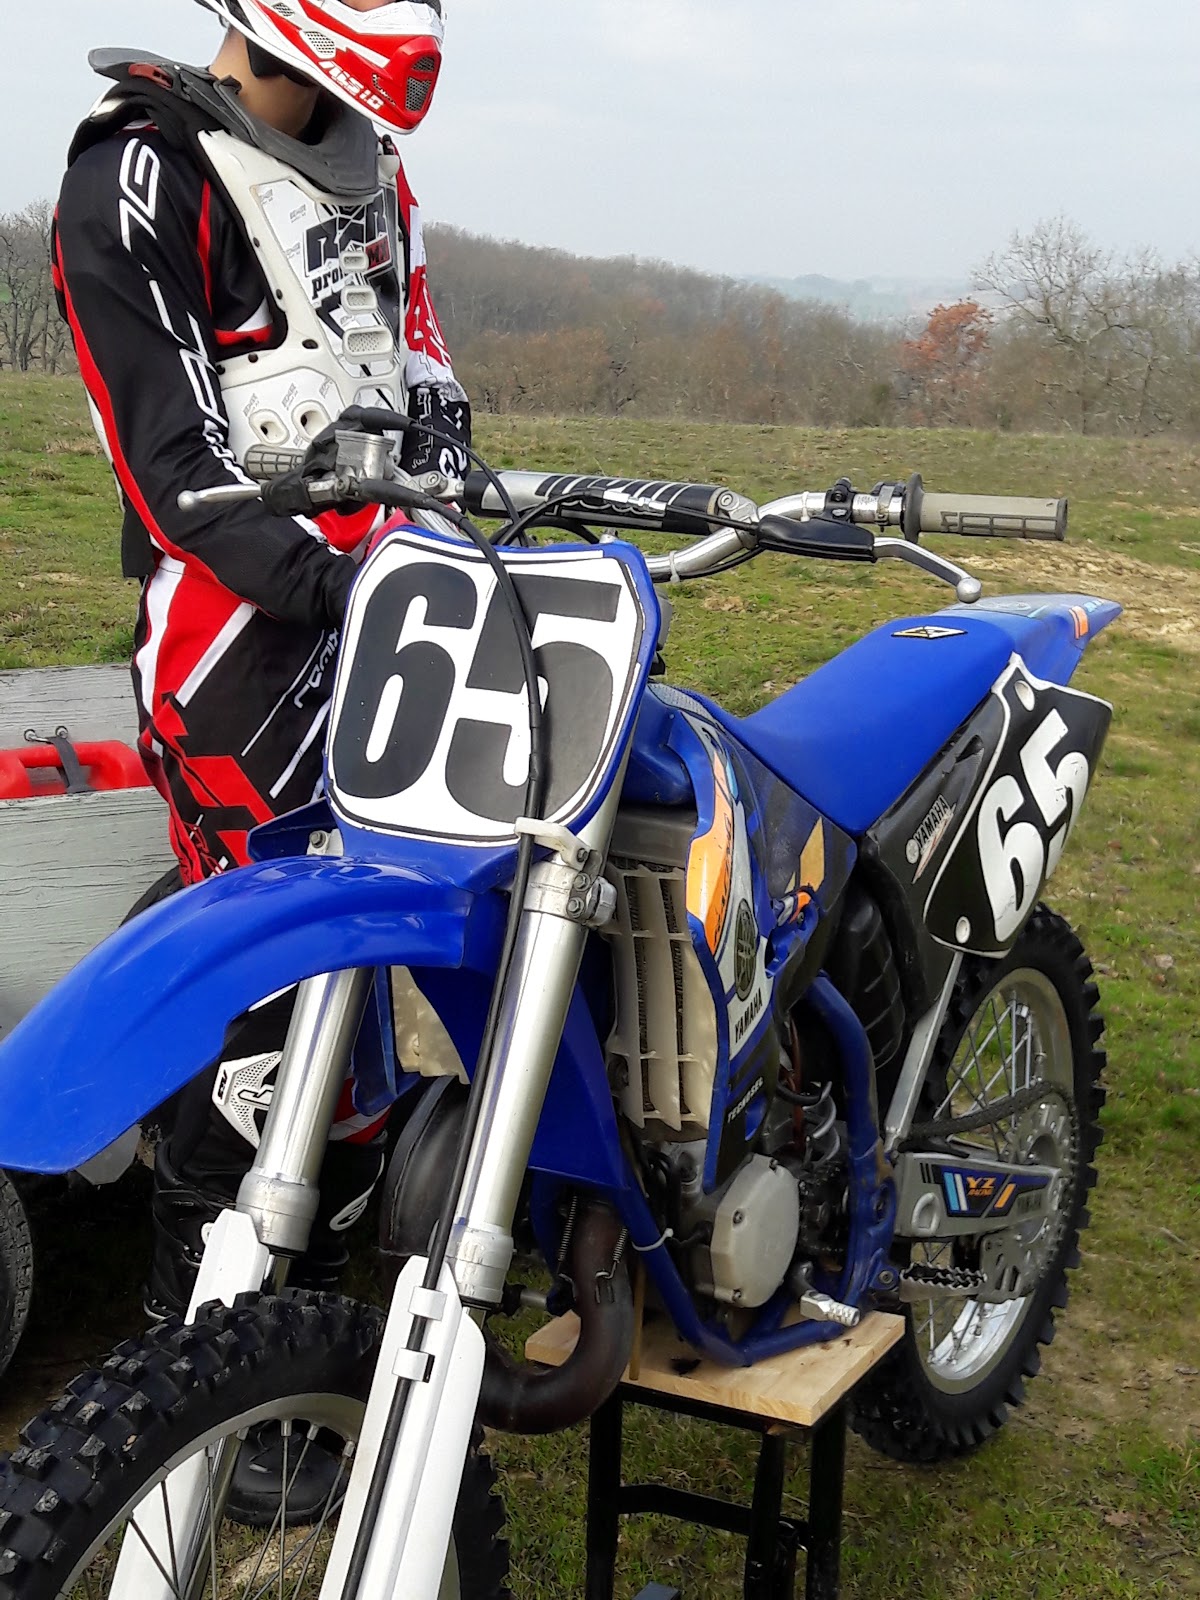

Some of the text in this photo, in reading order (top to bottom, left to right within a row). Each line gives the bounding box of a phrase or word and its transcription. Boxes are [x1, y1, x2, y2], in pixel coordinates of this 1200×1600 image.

[332, 561, 622, 824] 65
[912, 794, 951, 854] YAMAHA
[977, 708, 1089, 943] 65
[734, 987, 764, 1045] YAMAHA
[966, 1176, 997, 1189] YZ
